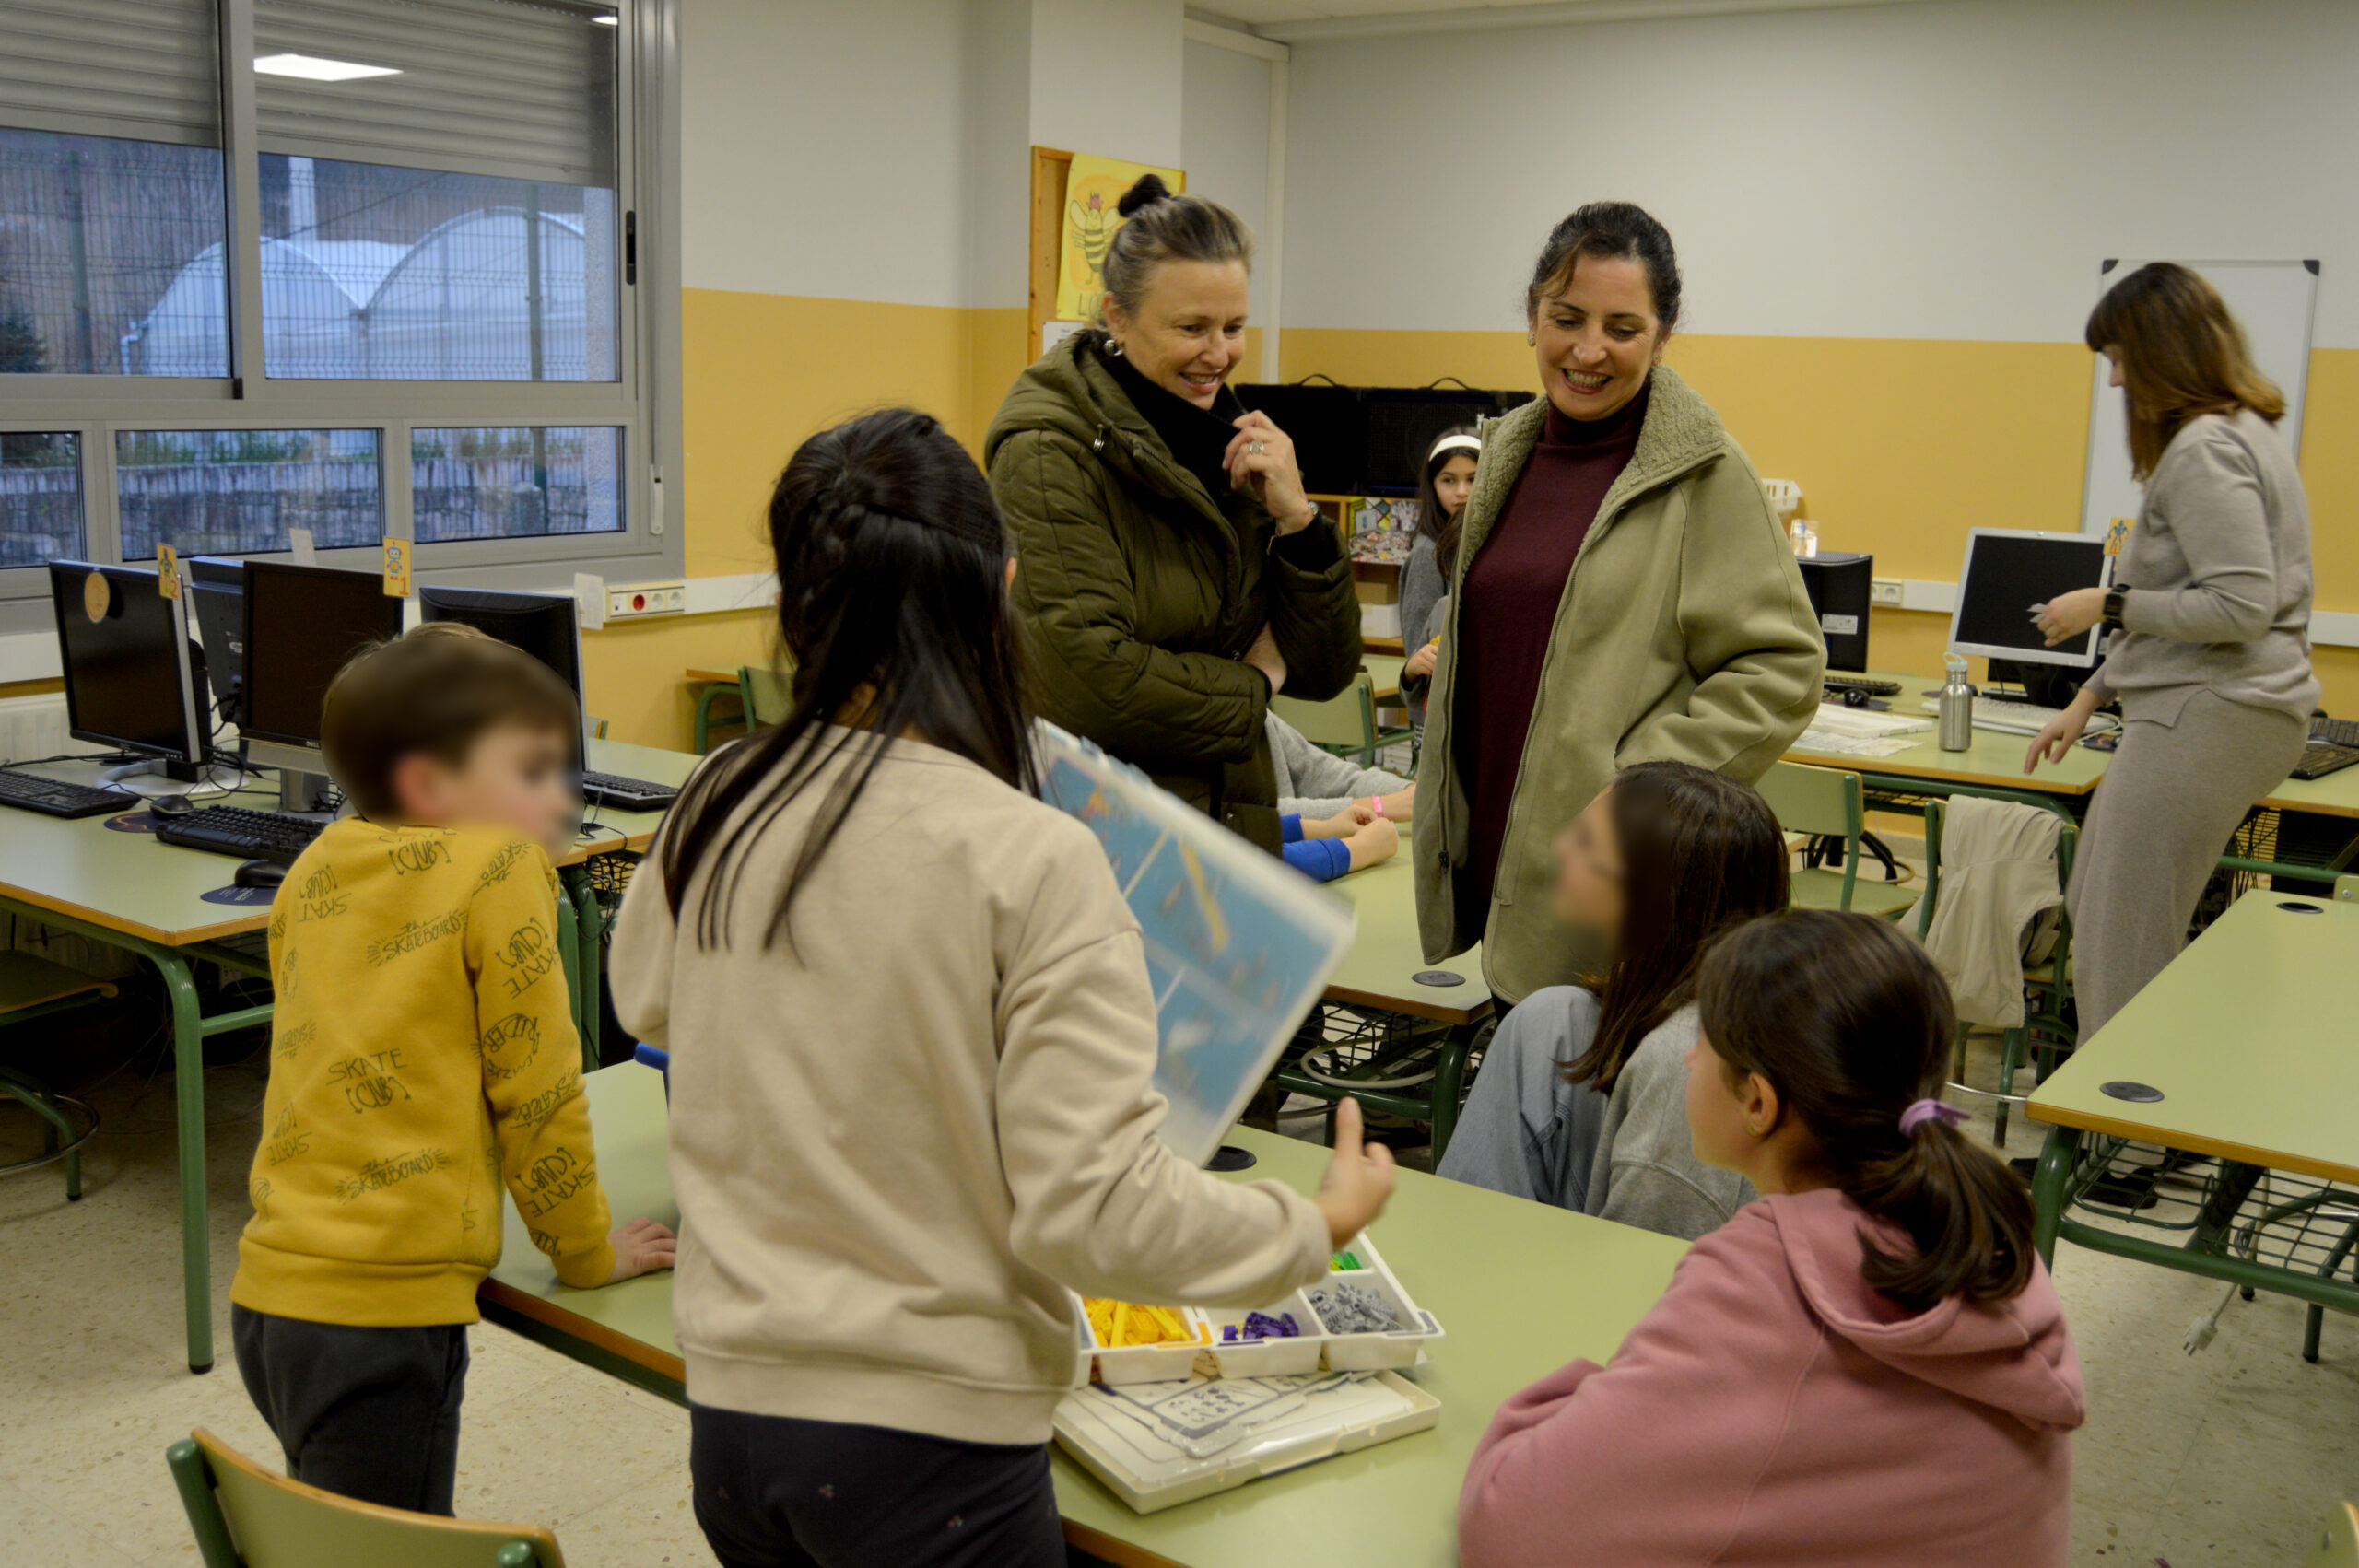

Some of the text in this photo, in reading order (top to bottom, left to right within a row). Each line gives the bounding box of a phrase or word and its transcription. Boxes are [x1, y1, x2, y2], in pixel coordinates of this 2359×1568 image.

[170, 580, 178, 598] 2
[399, 577, 408, 595] 1
[383, 915, 461, 960] SKATEBOARD
[483, 1016, 538, 1053] RIDER
[325, 1047, 408, 1085] SKATE
[356, 1076, 393, 1108] CLUB
[346, 1153, 434, 1199] SKATEBOARD
[523, 1158, 595, 1217] SKATE
[531, 1155, 567, 1188] CLUB
